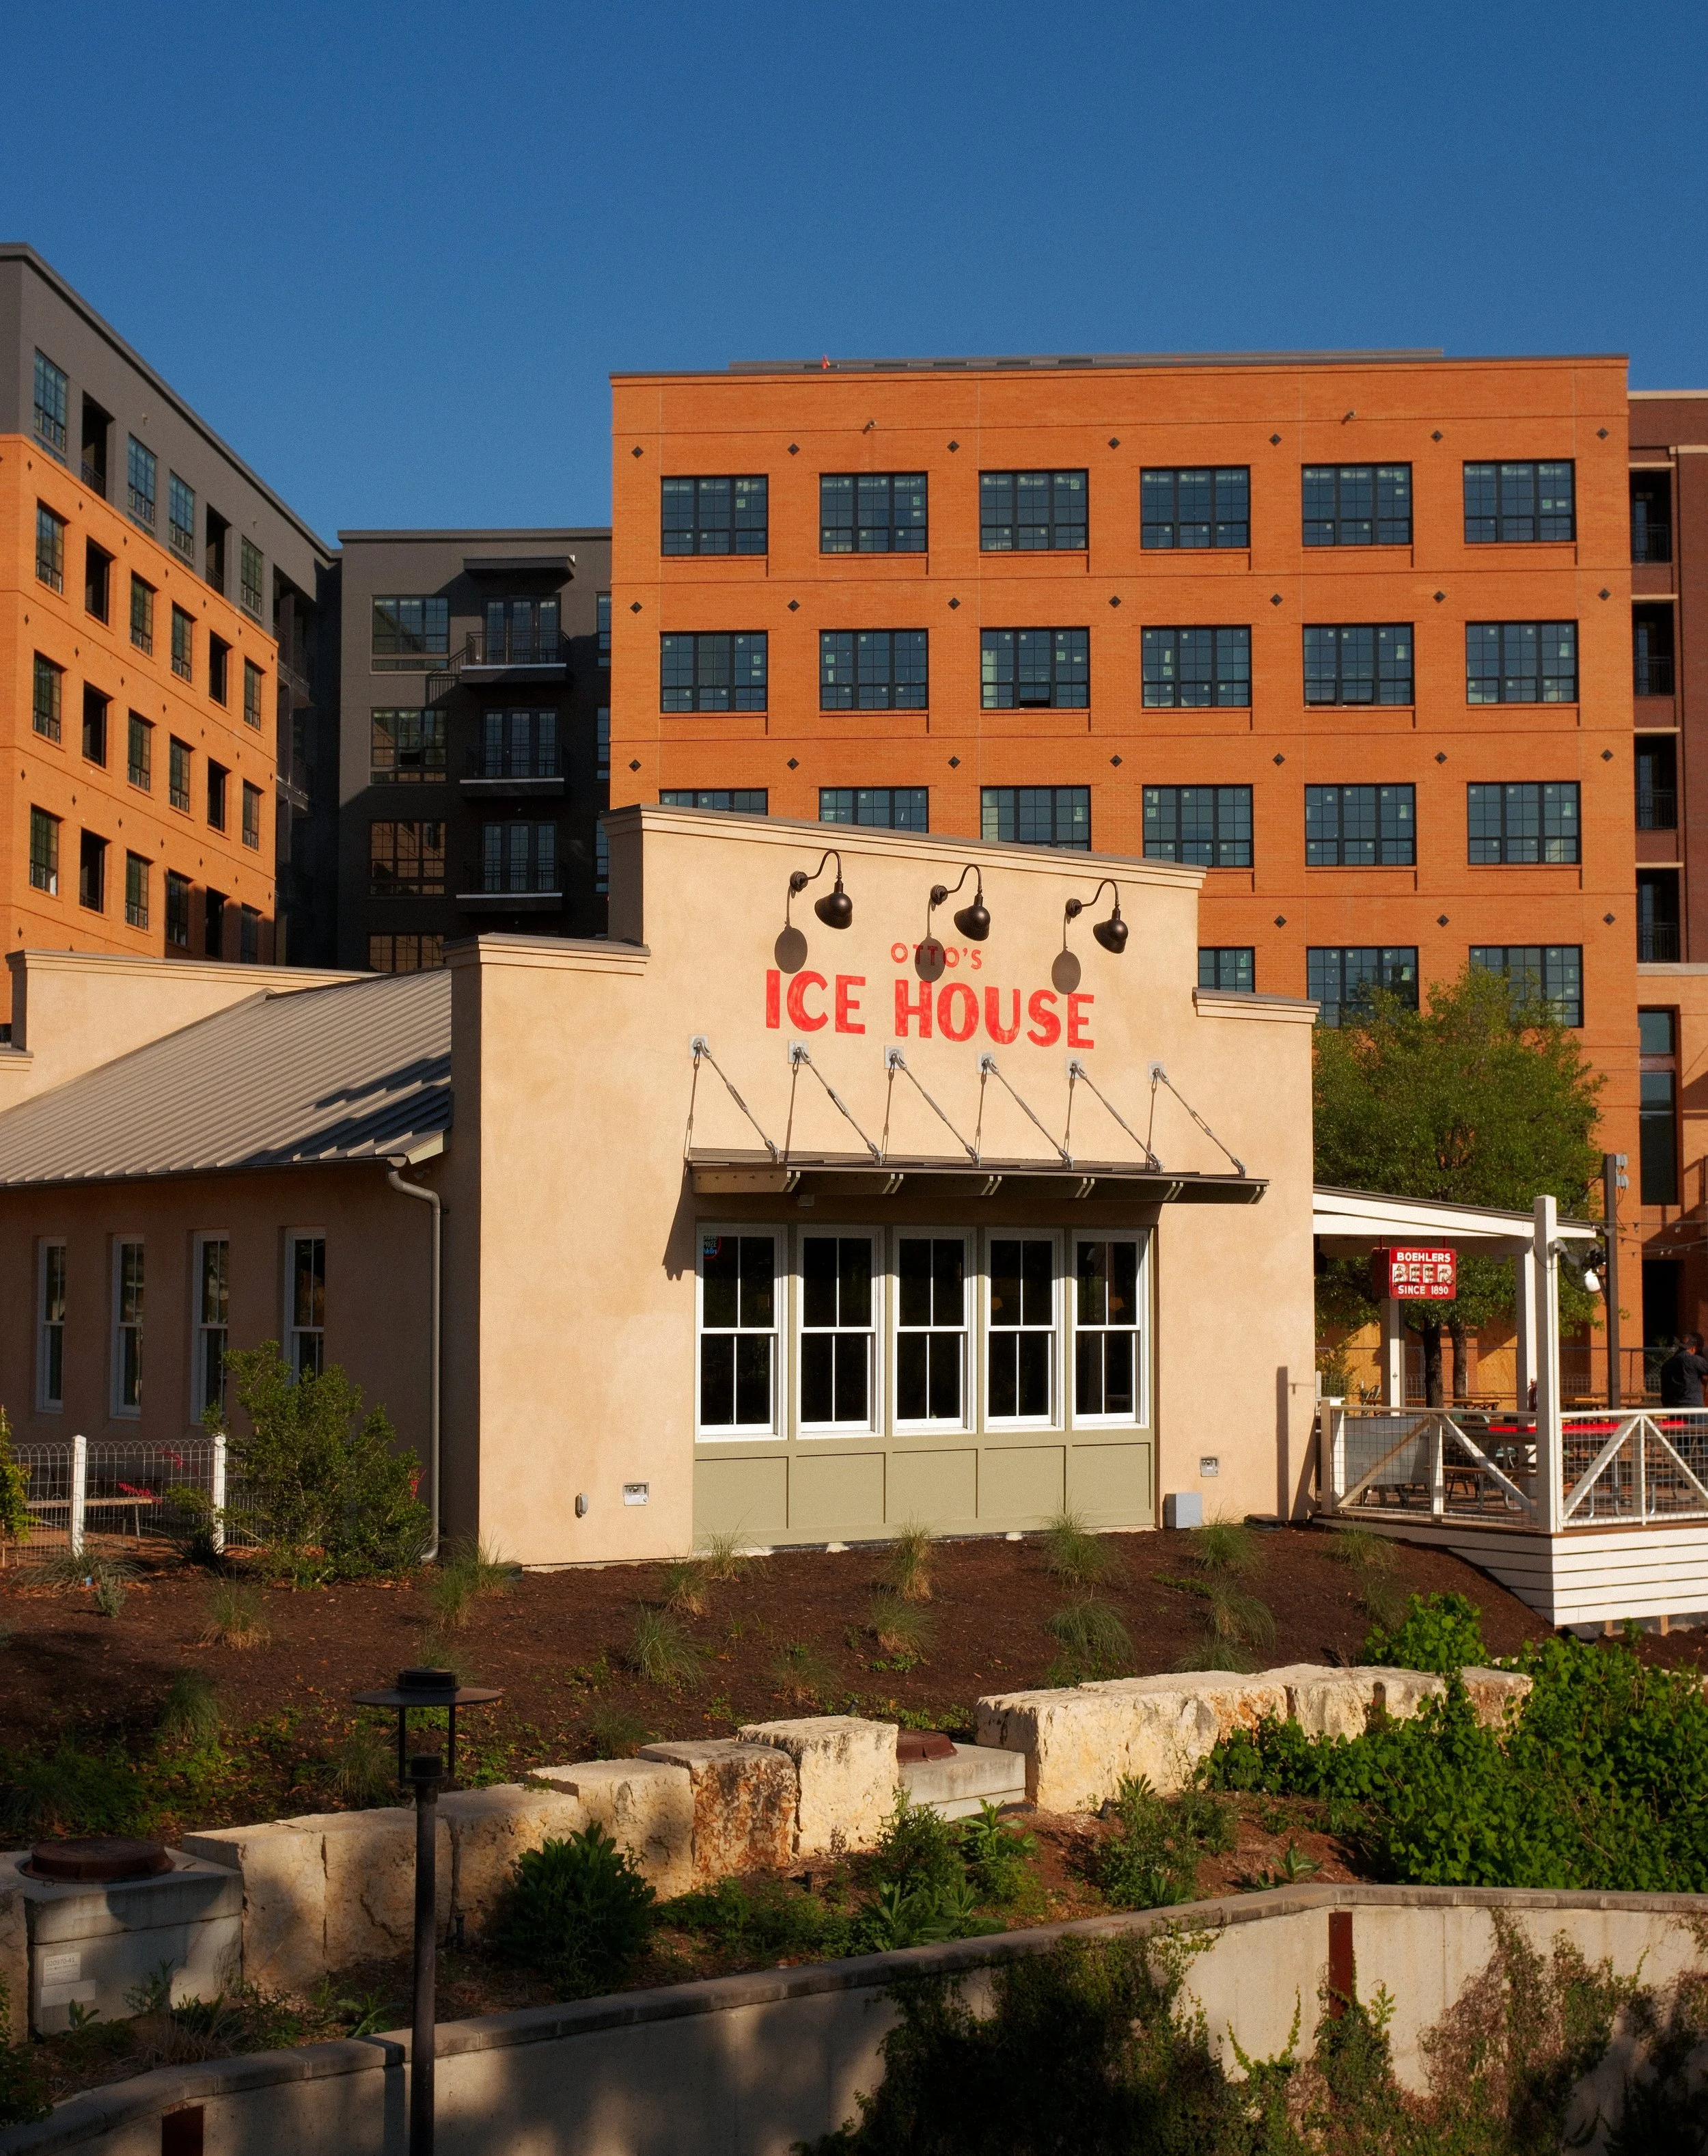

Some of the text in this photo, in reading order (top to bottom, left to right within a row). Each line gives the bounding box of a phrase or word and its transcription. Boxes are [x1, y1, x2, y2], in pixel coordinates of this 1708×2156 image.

[891, 942, 982, 970] OTTO'S
[766, 969, 1094, 1050] ICE HOUSE
[1396, 1252, 1450, 1262] BOEHLERS
[1392, 1264, 1452, 1283] BEER
[1398, 1285, 1448, 1295] SINCE 1890
